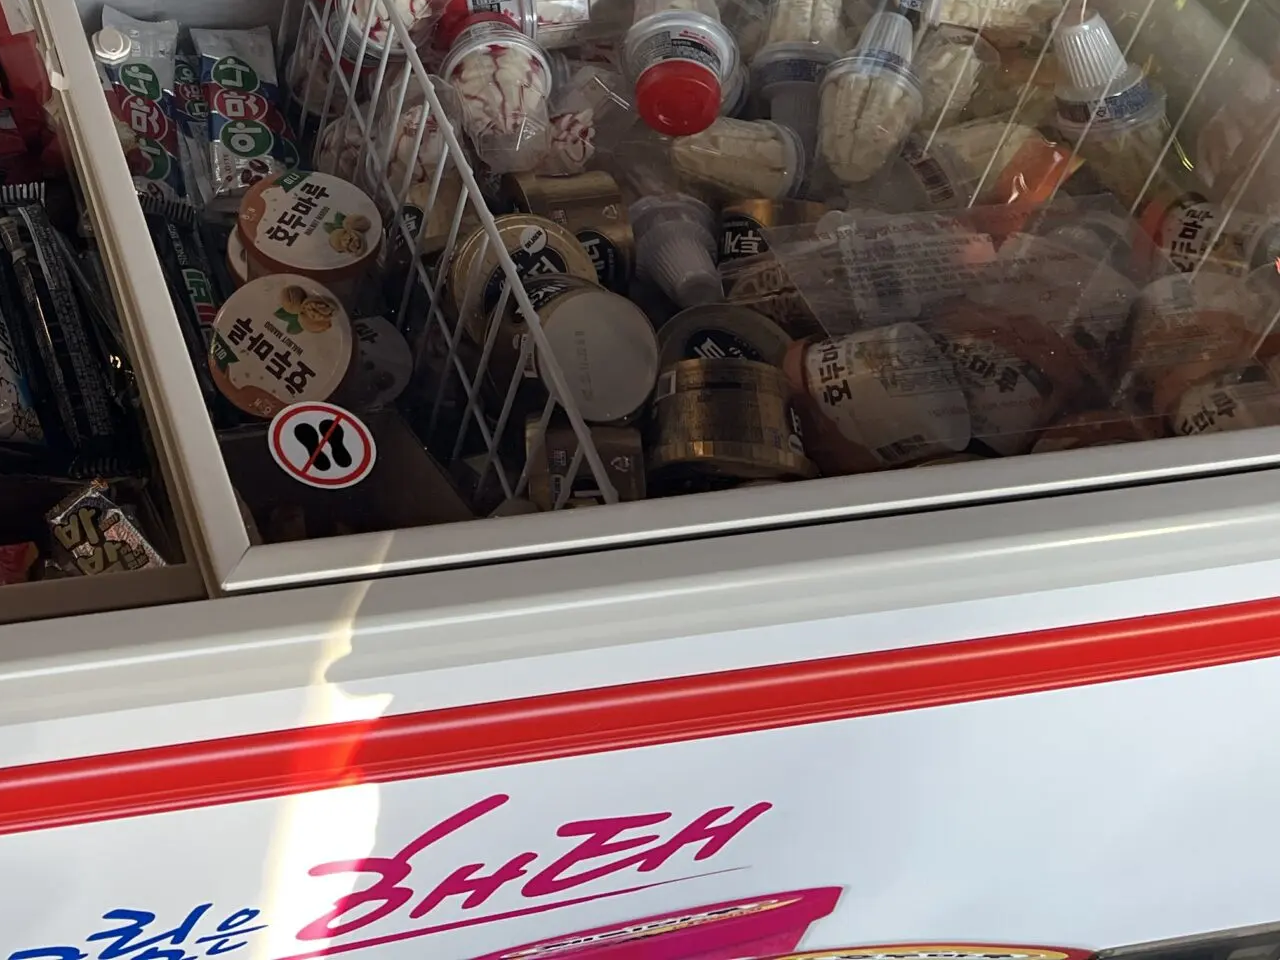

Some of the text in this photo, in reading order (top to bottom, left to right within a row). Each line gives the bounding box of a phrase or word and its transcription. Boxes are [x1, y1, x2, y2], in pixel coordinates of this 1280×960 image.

[268, 182, 330, 247] 호두마루
[227, 316, 317, 396] 호두마루
[295, 794, 773, 940] 해태
